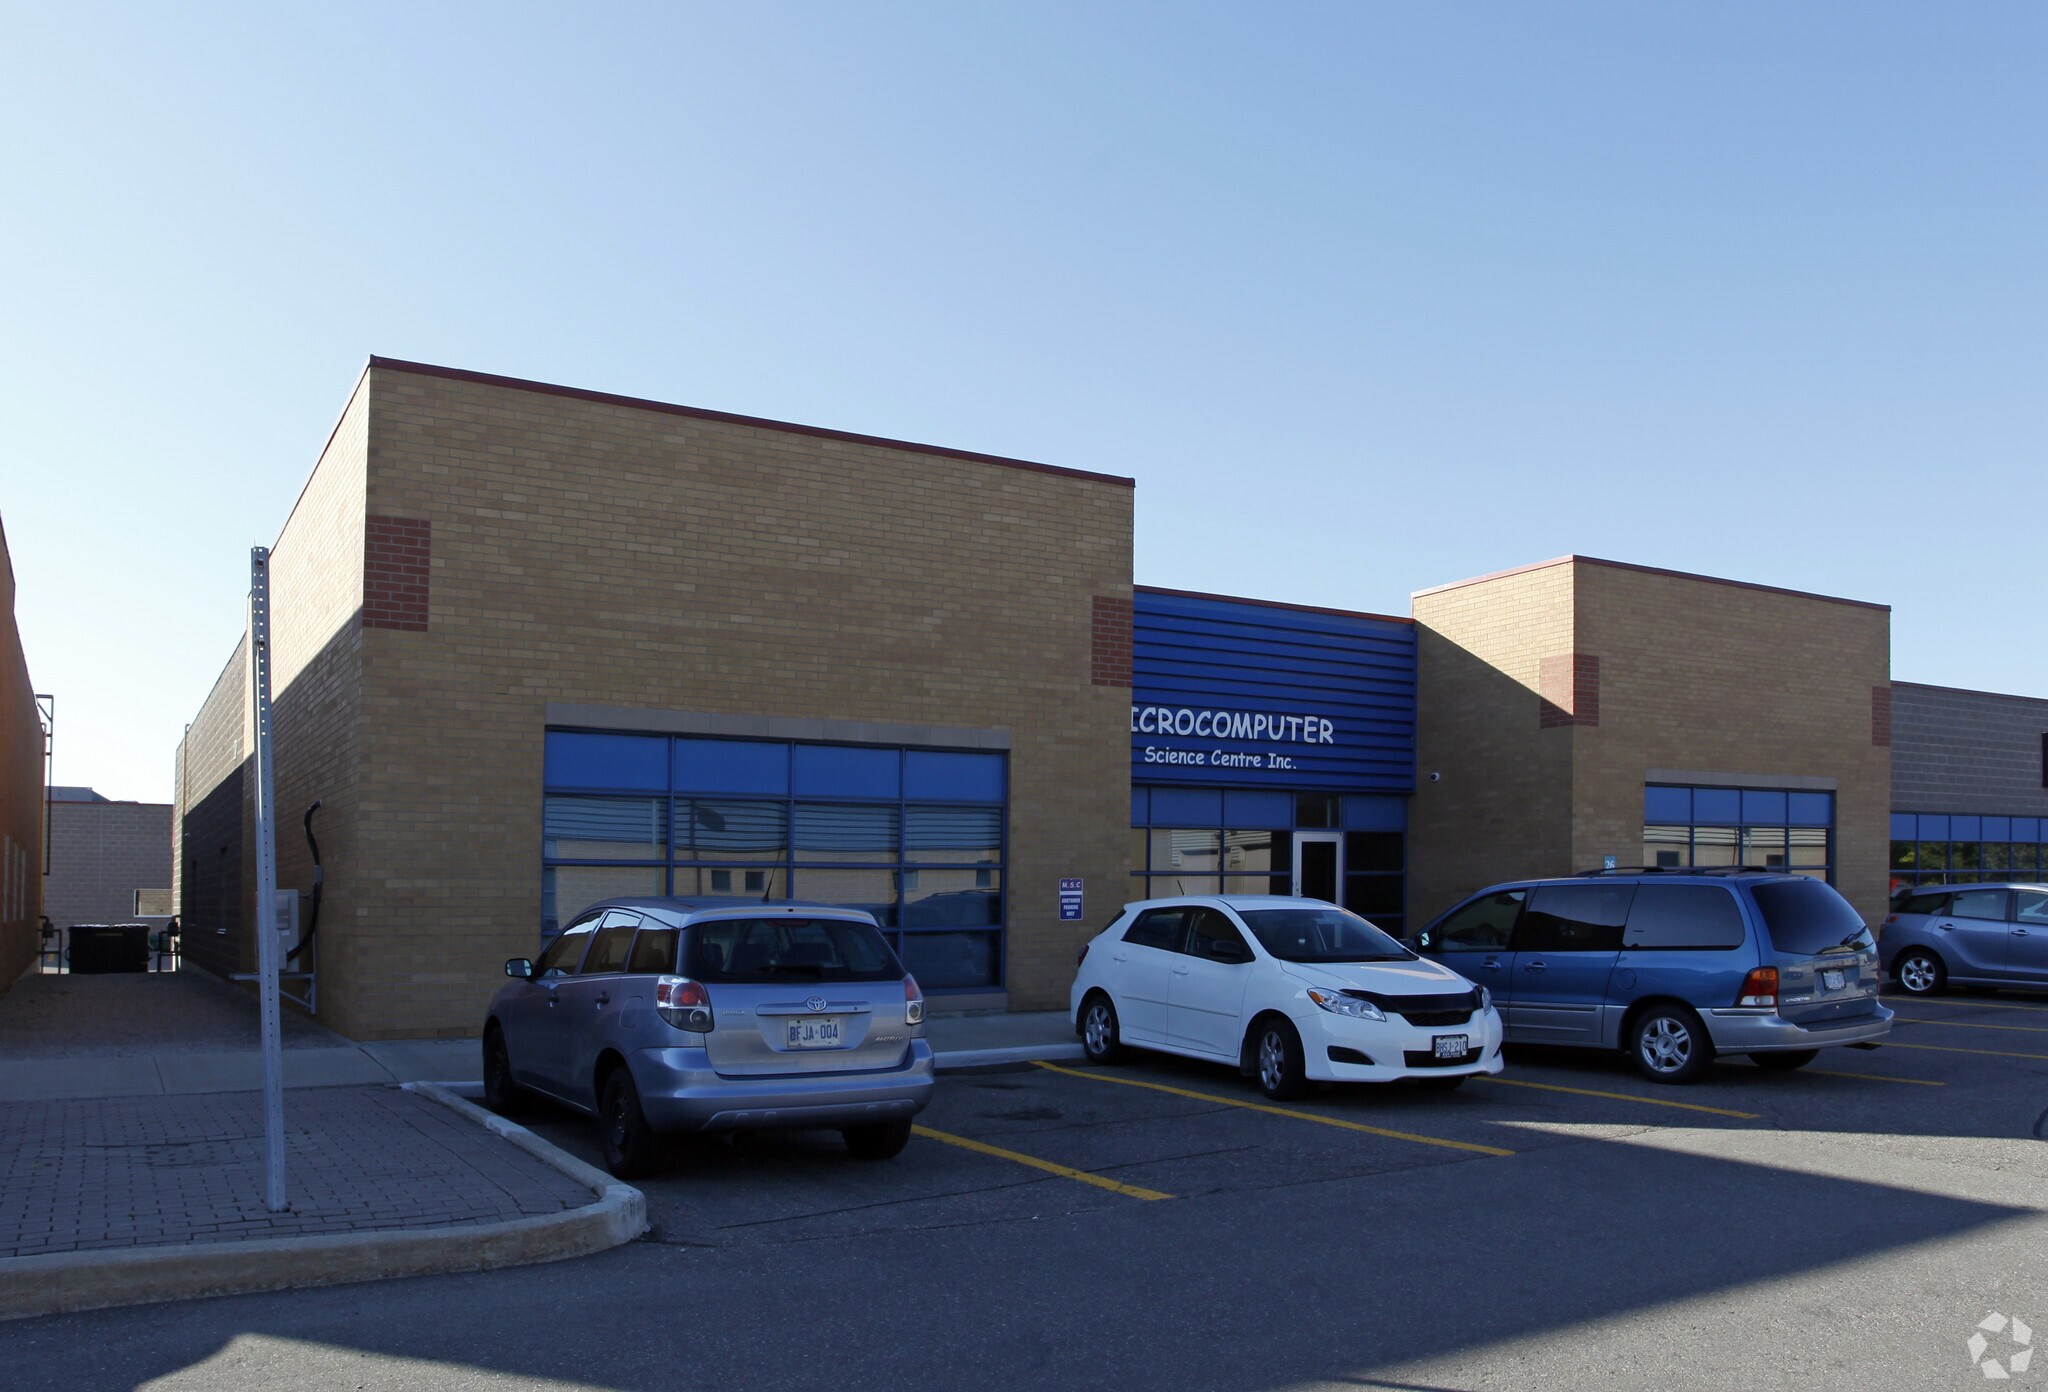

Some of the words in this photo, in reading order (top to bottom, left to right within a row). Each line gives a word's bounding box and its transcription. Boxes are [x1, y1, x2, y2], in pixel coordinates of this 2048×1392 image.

[1131, 707, 1334, 743] ICROCOMPUTER
[1144, 745, 1204, 766] Science
[1211, 749, 1262, 768] Centre
[1267, 752, 1297, 770] Inc.
